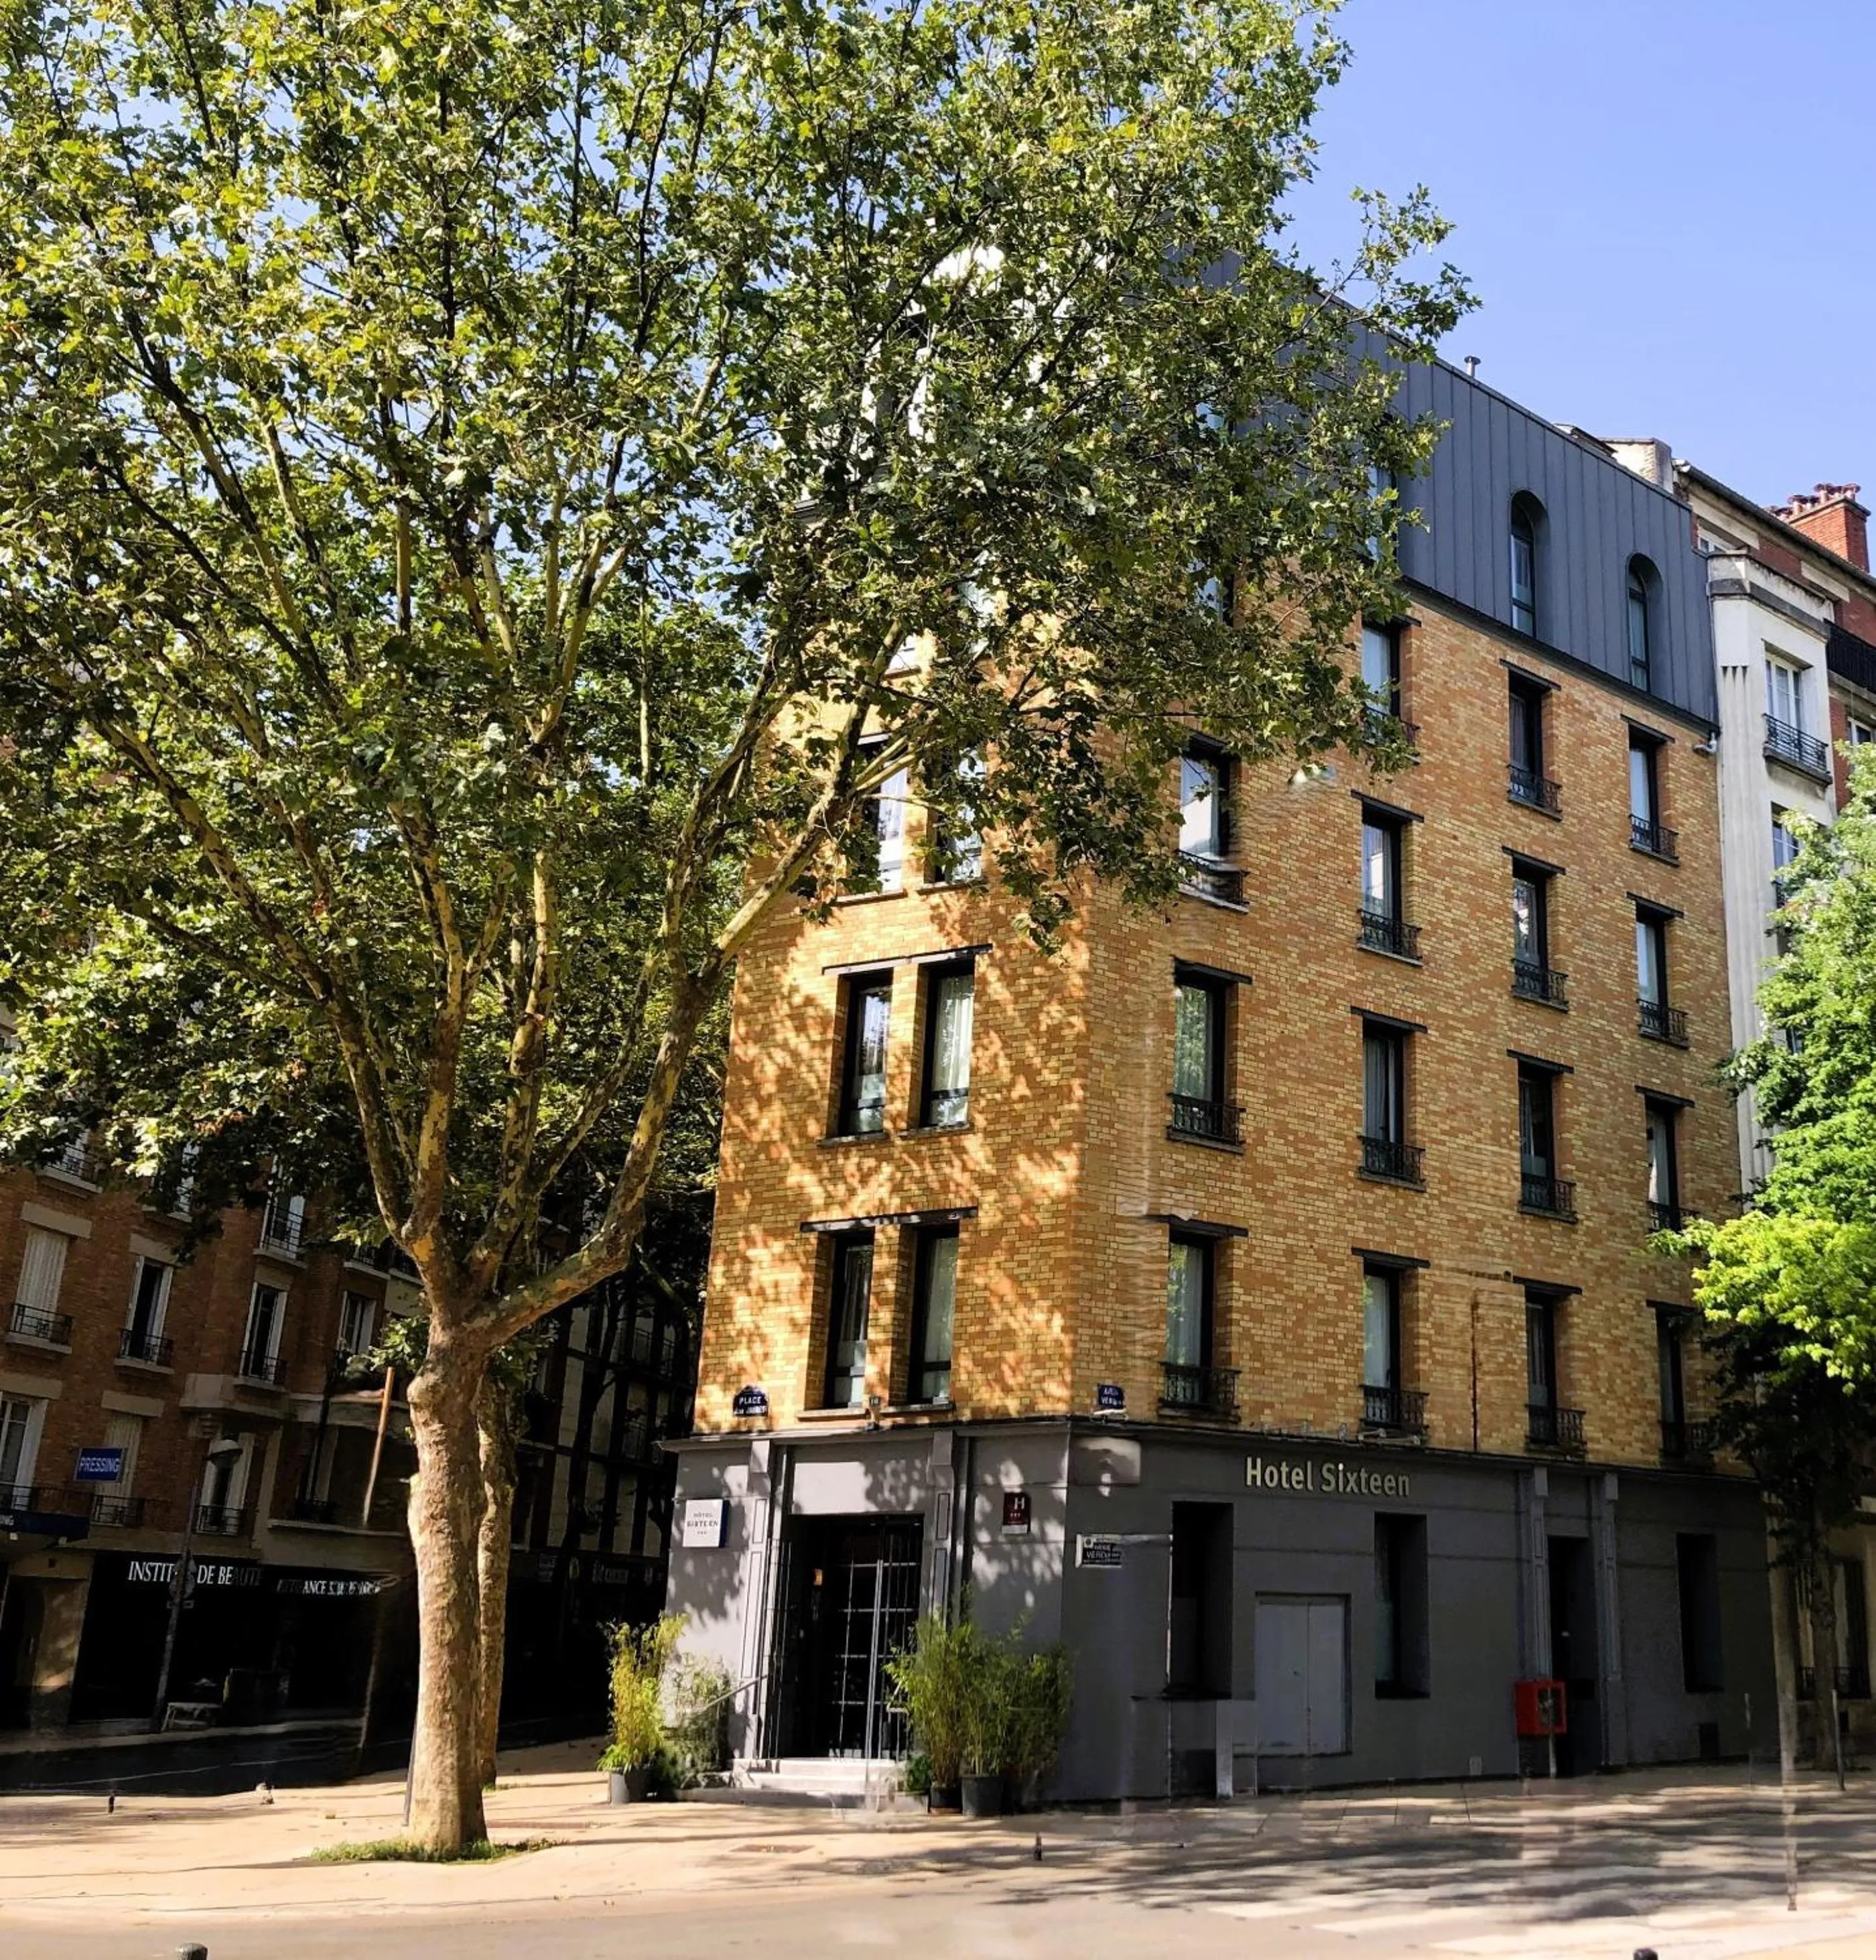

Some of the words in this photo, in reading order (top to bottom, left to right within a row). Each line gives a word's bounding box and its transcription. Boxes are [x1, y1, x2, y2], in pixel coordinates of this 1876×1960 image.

[739, 1396, 761, 1405] PLACE
[78, 1457, 121, 1472] PRESSING
[1246, 1456, 1314, 1491] Hotel
[1321, 1462, 1410, 1496] Sixteen
[1014, 1497, 1024, 1510] H
[128, 1561, 188, 1583] INSTIT
[197, 1565, 216, 1585] DE
